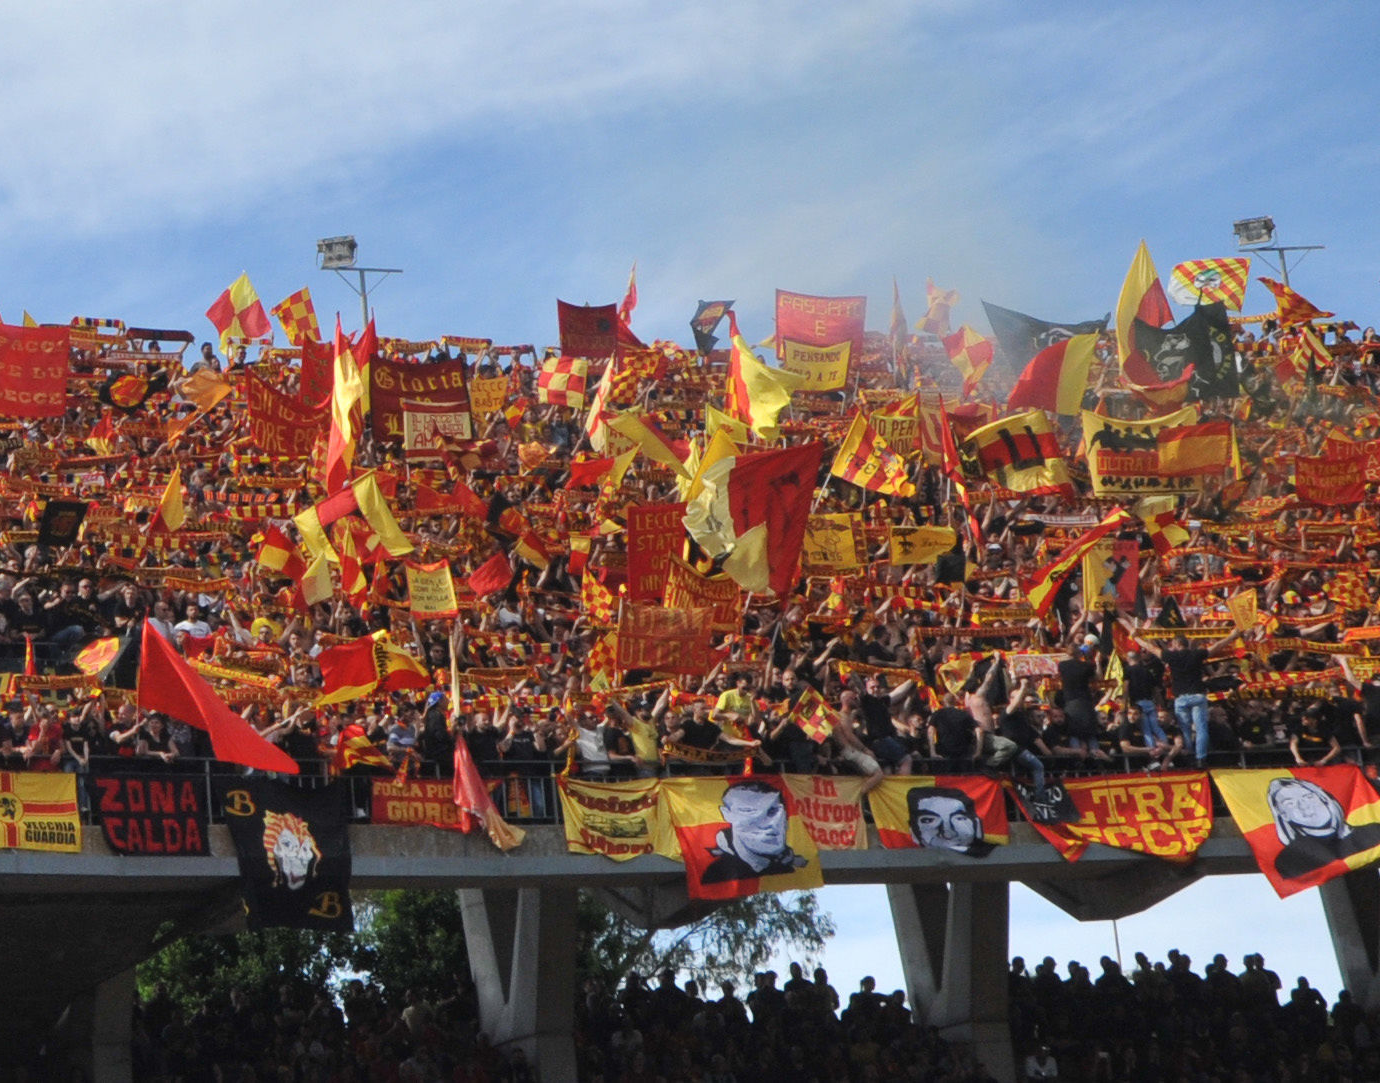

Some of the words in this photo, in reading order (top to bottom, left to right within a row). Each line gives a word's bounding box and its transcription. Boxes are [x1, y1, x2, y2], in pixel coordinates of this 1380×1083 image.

[374, 366, 464, 392] Gloria
[636, 511, 679, 531] LECCE
[96, 778, 198, 814] ZONA
[812, 776, 837, 797] In
[225, 789, 256, 817] B
[23, 821, 75, 833] VECCHIA
[24, 831, 77, 846] GUARDIA
[102, 817, 202, 853] CALDA
